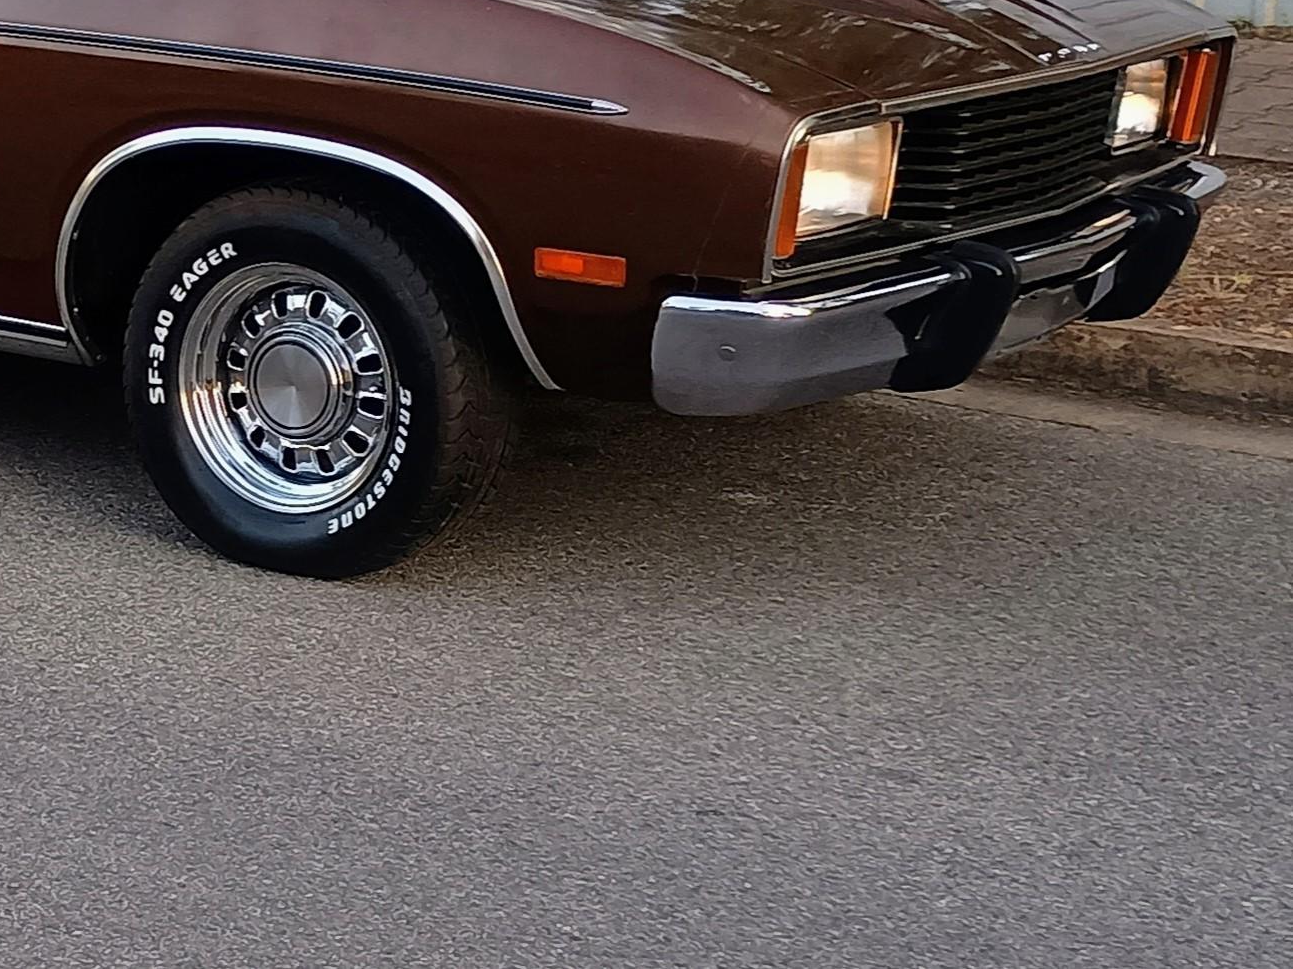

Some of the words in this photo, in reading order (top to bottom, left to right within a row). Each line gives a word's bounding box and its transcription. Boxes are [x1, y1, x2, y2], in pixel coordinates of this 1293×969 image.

[148, 309, 174, 404] SF-340
[169, 242, 238, 302] EAGER
[327, 386, 412, 534] BRIDGESTONE
